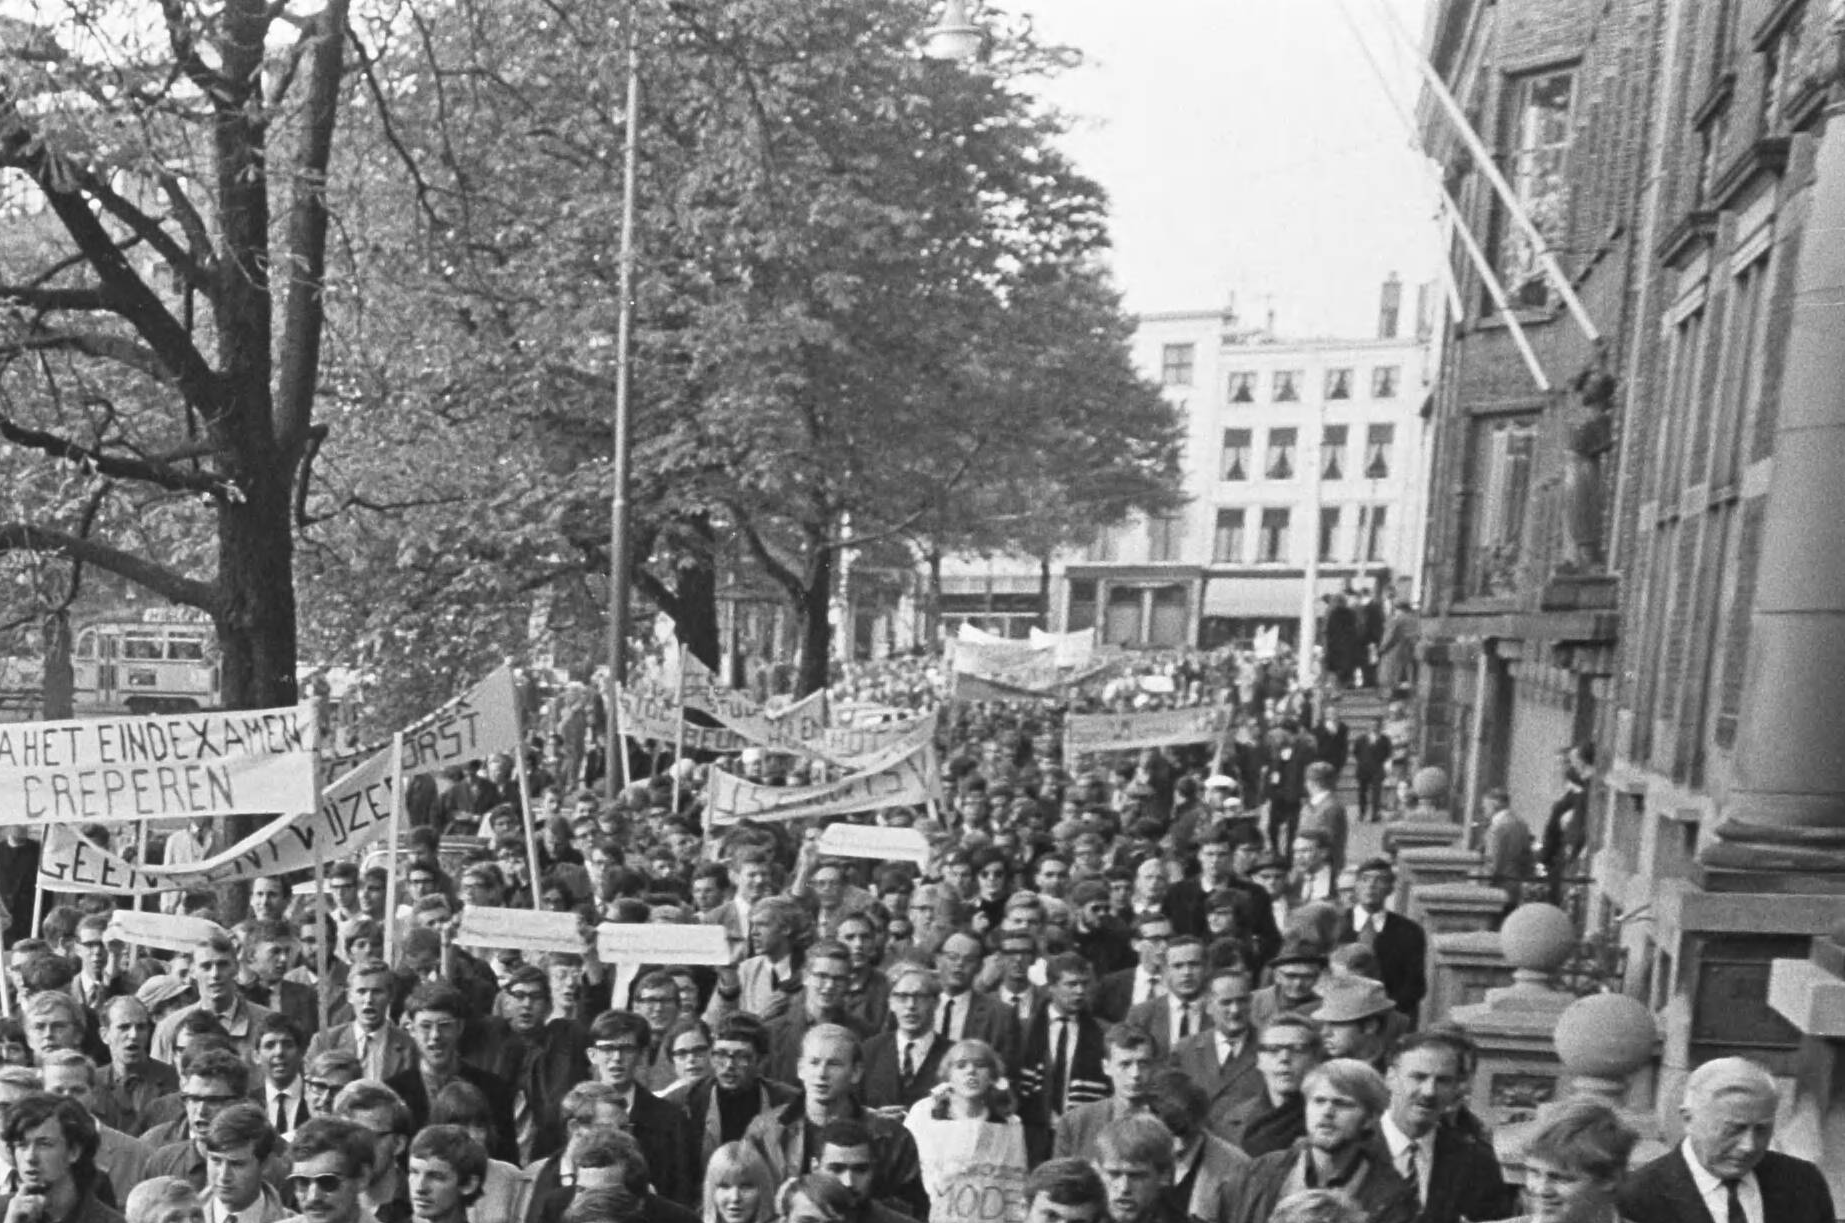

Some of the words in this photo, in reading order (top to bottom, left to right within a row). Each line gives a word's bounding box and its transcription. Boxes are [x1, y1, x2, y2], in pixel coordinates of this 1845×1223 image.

[23, 726, 84, 766] HET
[97, 713, 304, 763] EINDEXAMEN
[24, 766, 234, 818] CREPEREN
